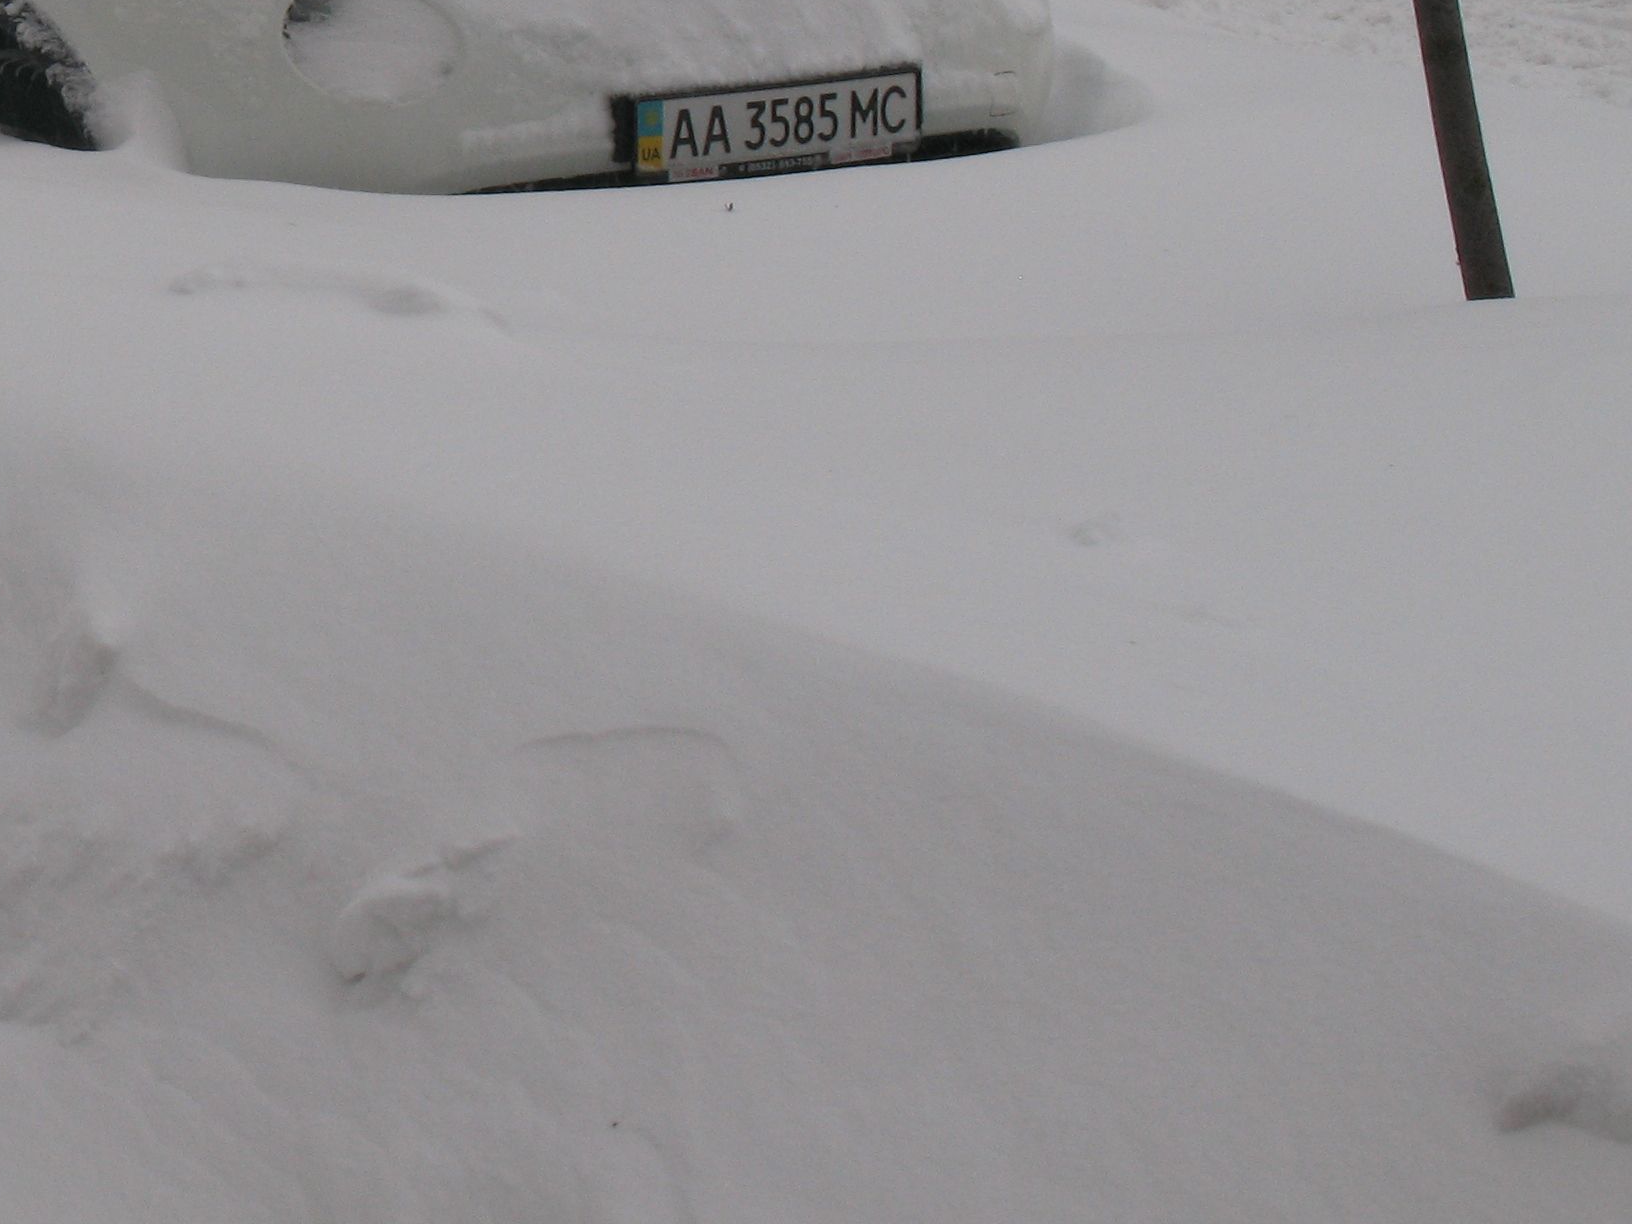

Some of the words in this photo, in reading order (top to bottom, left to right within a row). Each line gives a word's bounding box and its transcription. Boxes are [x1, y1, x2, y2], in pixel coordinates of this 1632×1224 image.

[670, 105, 731, 159] AA
[745, 92, 839, 151] 3585
[851, 85, 907, 139] MC
[642, 147, 661, 162] UA
